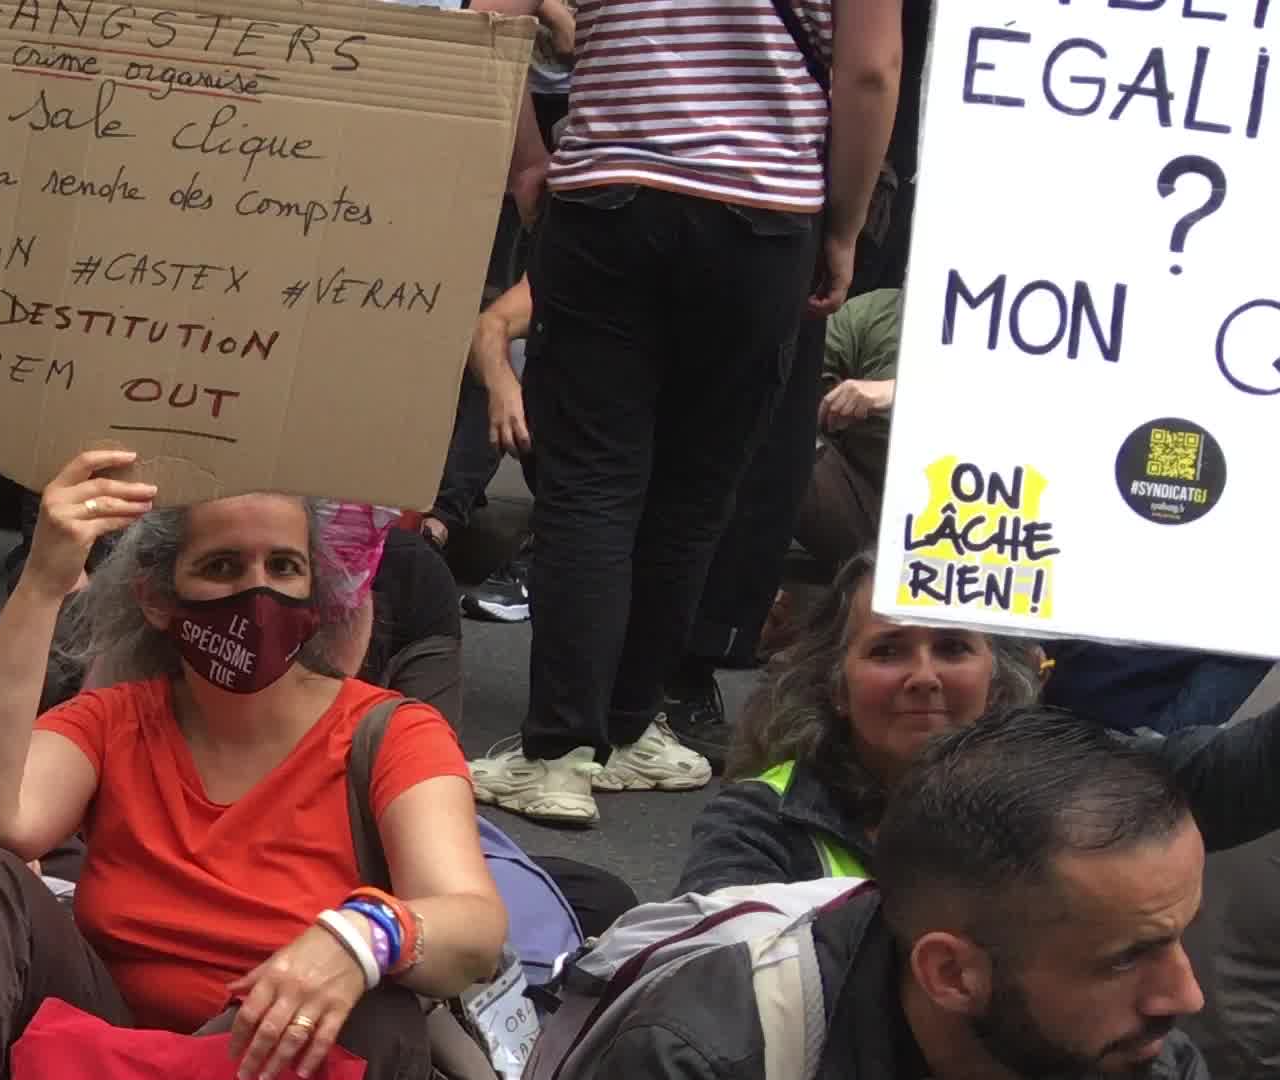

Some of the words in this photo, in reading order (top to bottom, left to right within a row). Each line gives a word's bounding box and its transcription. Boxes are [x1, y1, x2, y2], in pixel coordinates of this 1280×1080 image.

[13, 45, 99, 76] crime
[8, 80, 136, 140] sale
[172, 103, 322, 180] clique
[169, 172, 214, 210] des
[1157, 156, 1227, 275] ?
[72, 251, 249, 294] #CASTEX
[281, 265, 442, 314] #VERAN
[941, 269, 1127, 363] MON
[120, 377, 240, 419] OUT
[951, 462, 1023, 509] ON
[1130, 480, 1208, 504] #SYNDICATGJ
[904, 503, 1060, 561] LÂCHE
[909, 561, 1014, 610] RIEN
[180, 620, 257, 674] SPÉCISME
[228, 614, 249, 640] LE
[208, 660, 237, 688] TUE
